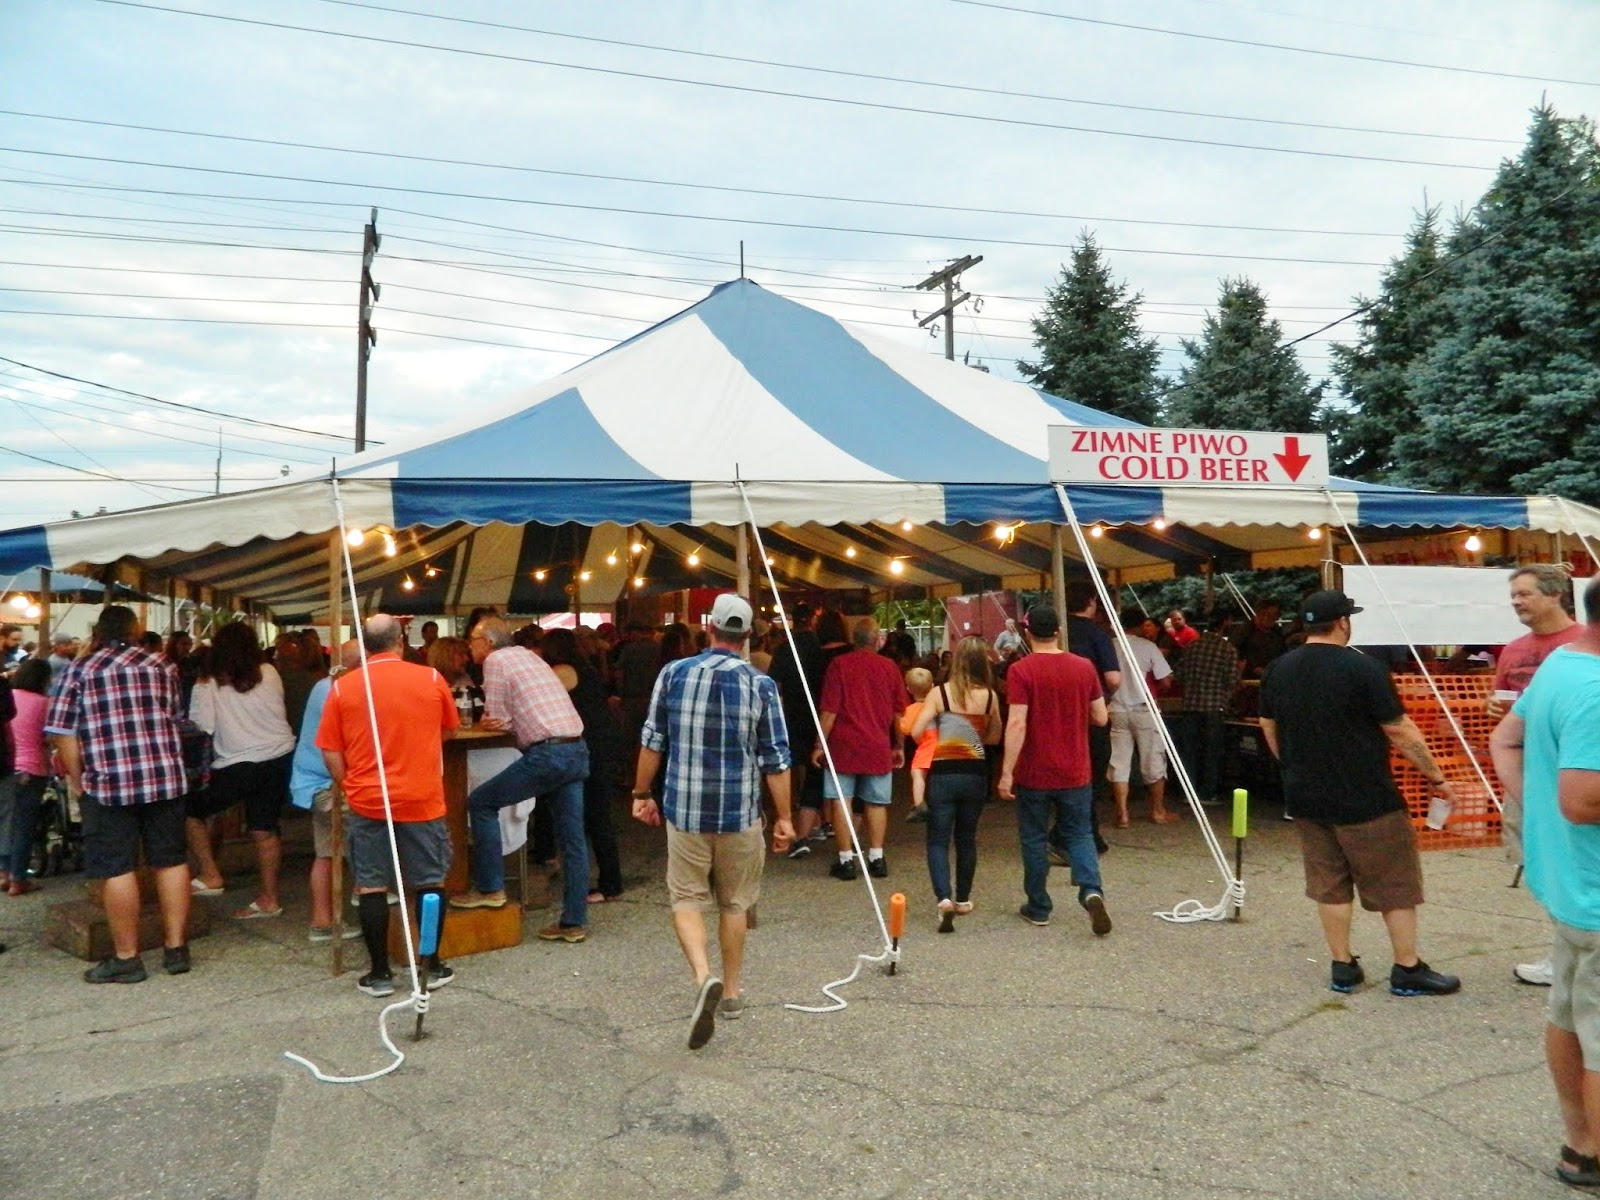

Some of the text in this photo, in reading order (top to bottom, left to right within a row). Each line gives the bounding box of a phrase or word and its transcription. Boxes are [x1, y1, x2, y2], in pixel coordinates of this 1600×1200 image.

[1071, 430, 1248, 456] ZIMNE PIWO
[1098, 455, 1270, 482] COLD BEER
